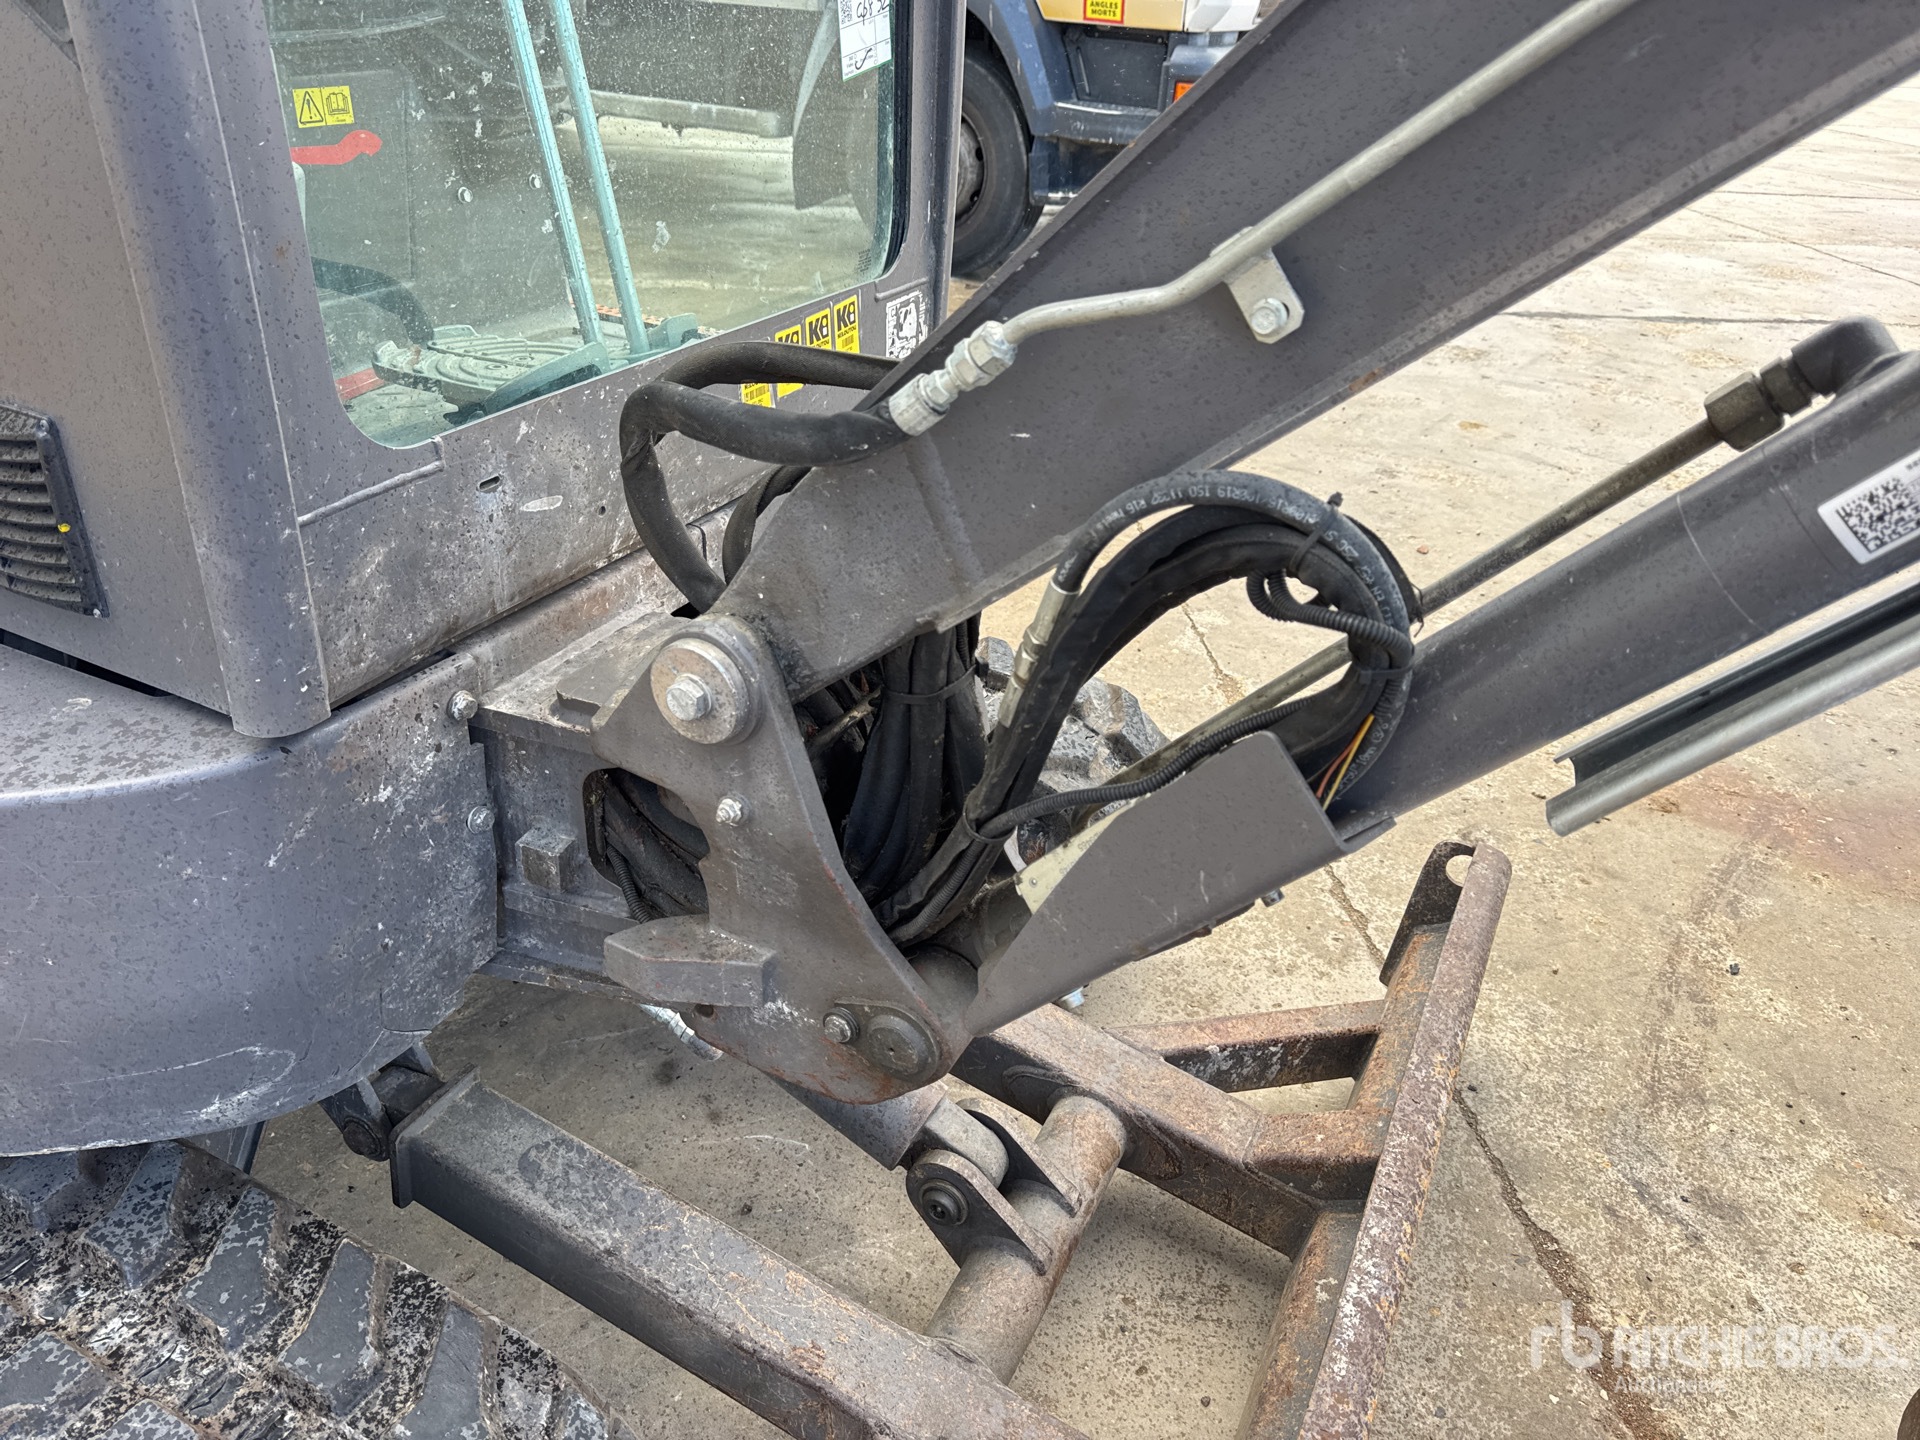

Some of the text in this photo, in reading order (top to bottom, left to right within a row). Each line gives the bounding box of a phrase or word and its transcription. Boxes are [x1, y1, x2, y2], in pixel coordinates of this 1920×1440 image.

[1090, 1, 1118, 9] ANGLES
[1091, 8, 1117, 17] MORTS
[1124, 496, 1148, 514] R16
[1371, 585, 1385, 602] EN
